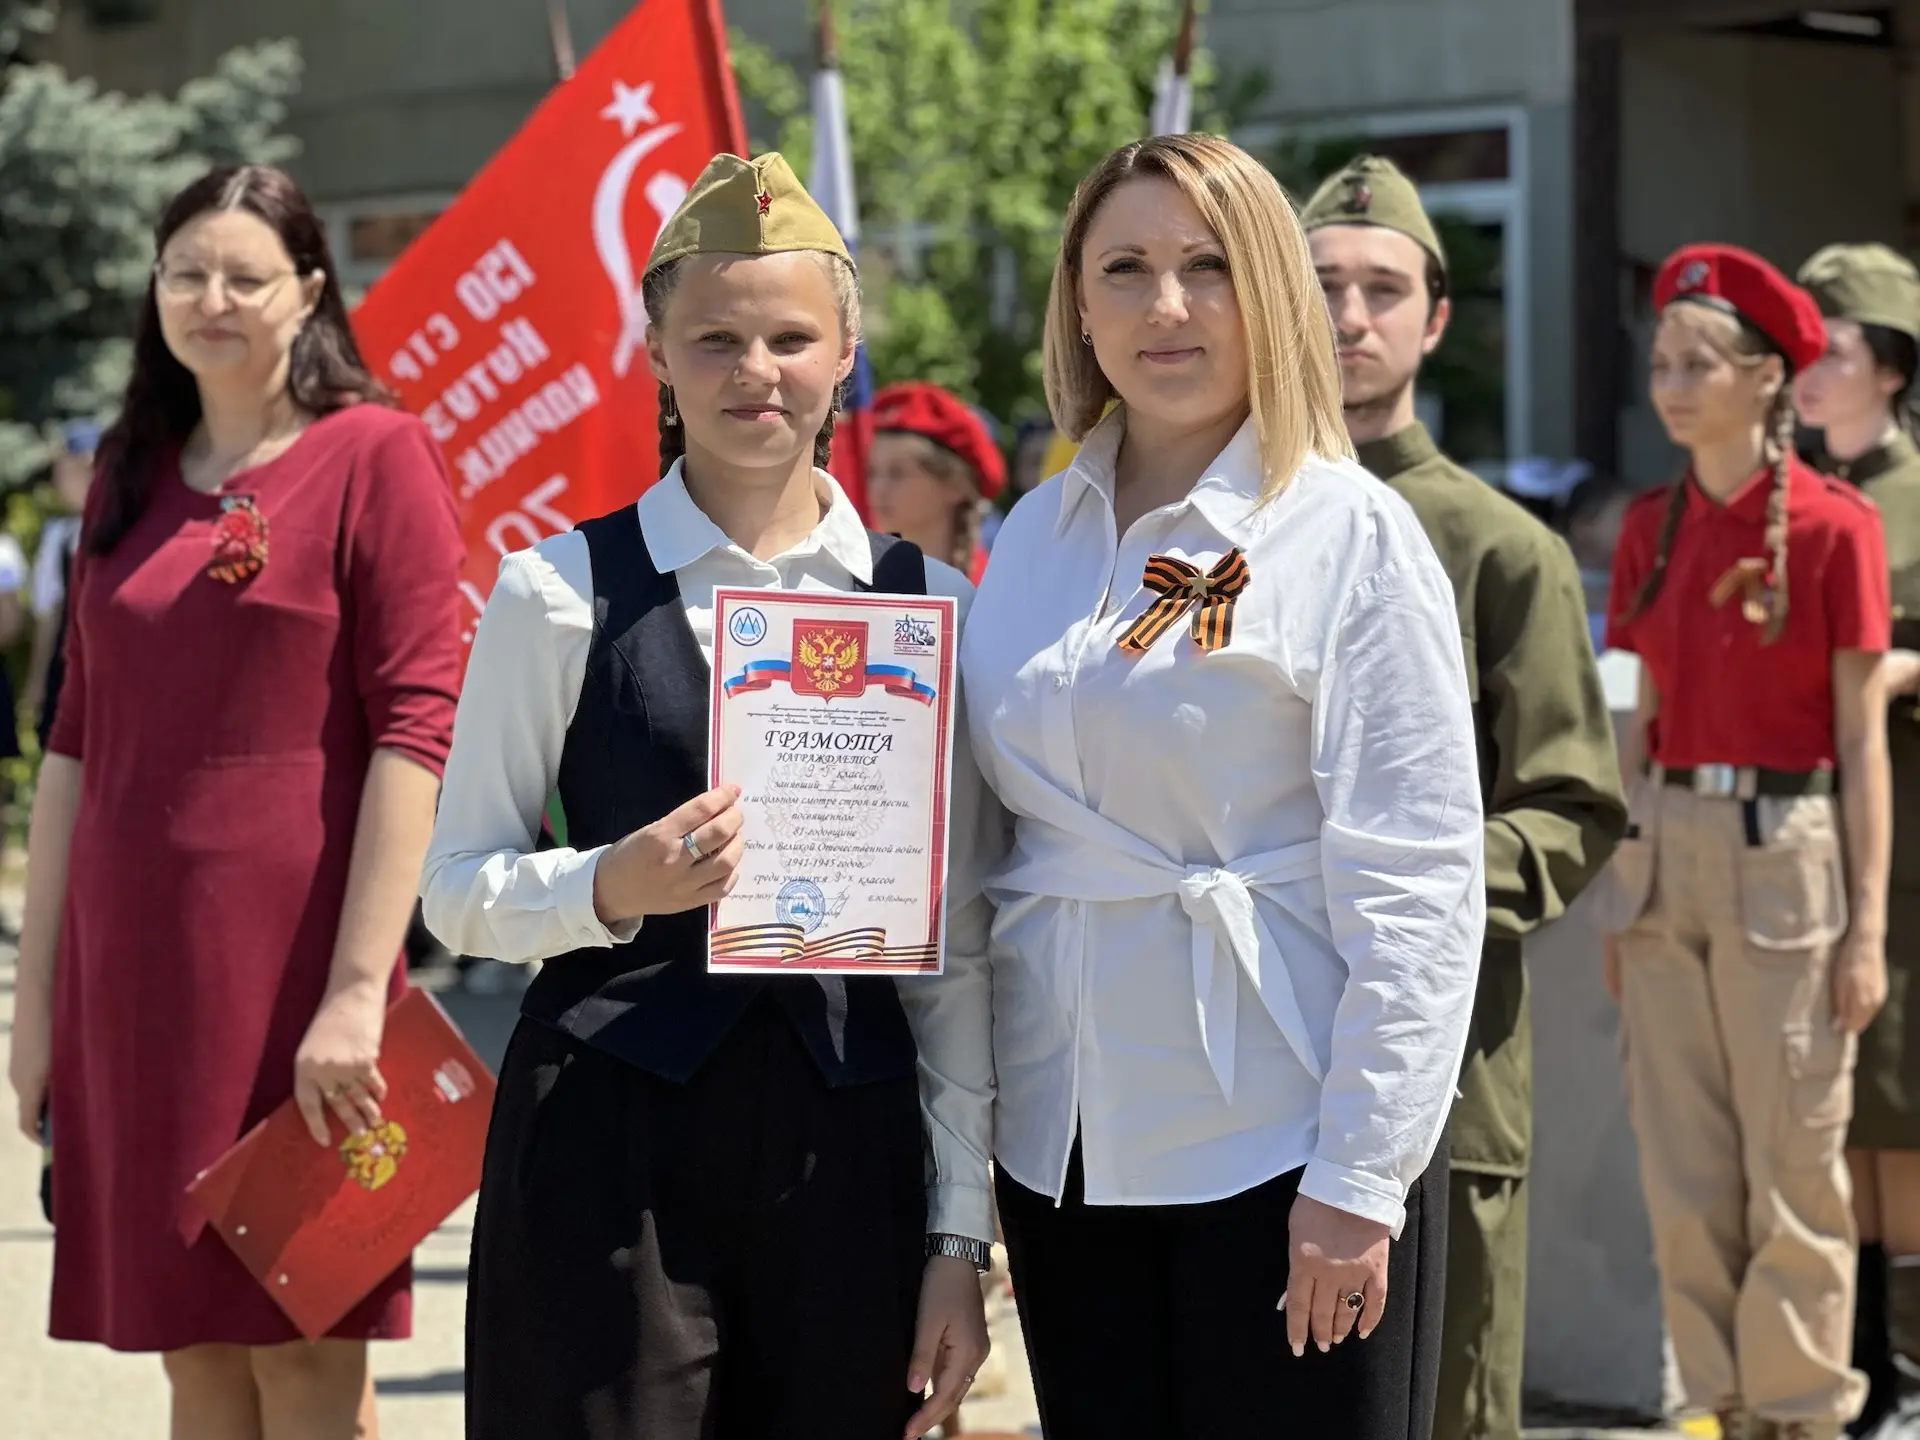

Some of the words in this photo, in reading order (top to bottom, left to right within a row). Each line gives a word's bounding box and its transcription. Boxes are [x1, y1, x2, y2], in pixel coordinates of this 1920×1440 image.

[894, 622, 910, 633] 20
[894, 633, 910, 642] 26
[764, 730, 894, 752] ГРАМОТА
[776, 752, 880, 766] НАГРАЖДАЕТСЯ
[774, 780, 820, 790] занявший
[751, 795, 799, 806] школьном
[801, 797, 837, 808] смотре
[838, 799, 869, 809] строя
[791, 812, 855, 823] посвященном
[744, 839, 765, 851] беды
[775, 841, 816, 854] Великой
[817, 842, 894, 854] Отечественной
[895, 845, 924, 855] войне
[787, 858, 836, 868] 1941-1945
[753, 871, 780, 885] среди
[858, 877, 896, 887] классов
